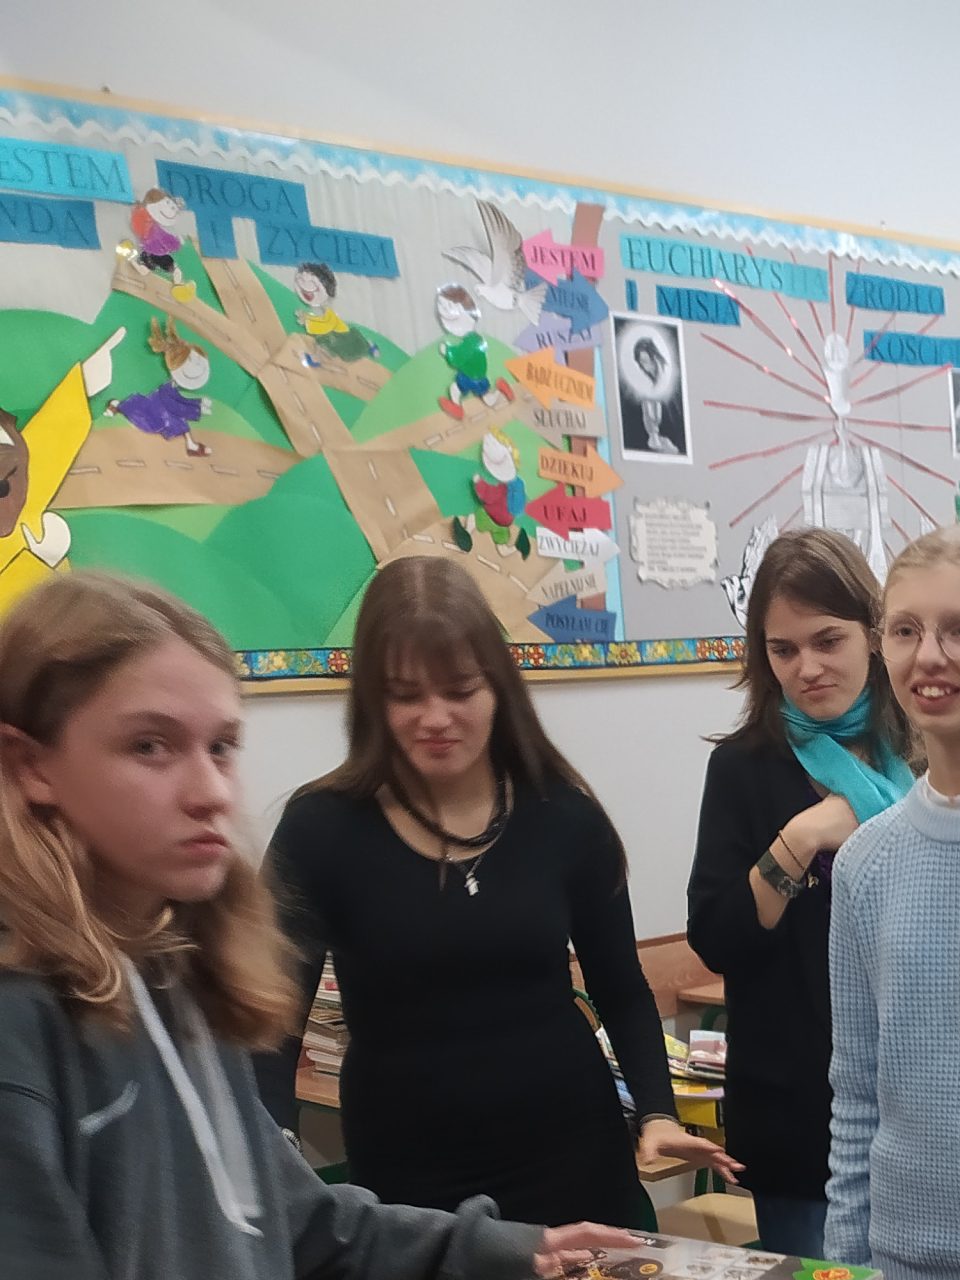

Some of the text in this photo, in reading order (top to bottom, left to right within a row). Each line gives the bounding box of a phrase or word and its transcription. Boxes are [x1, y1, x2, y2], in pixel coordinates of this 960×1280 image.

[167, 171, 298, 219] DROGA
[530, 245, 596, 272] JESTEM
[542, 504, 588, 523] UFAJ
